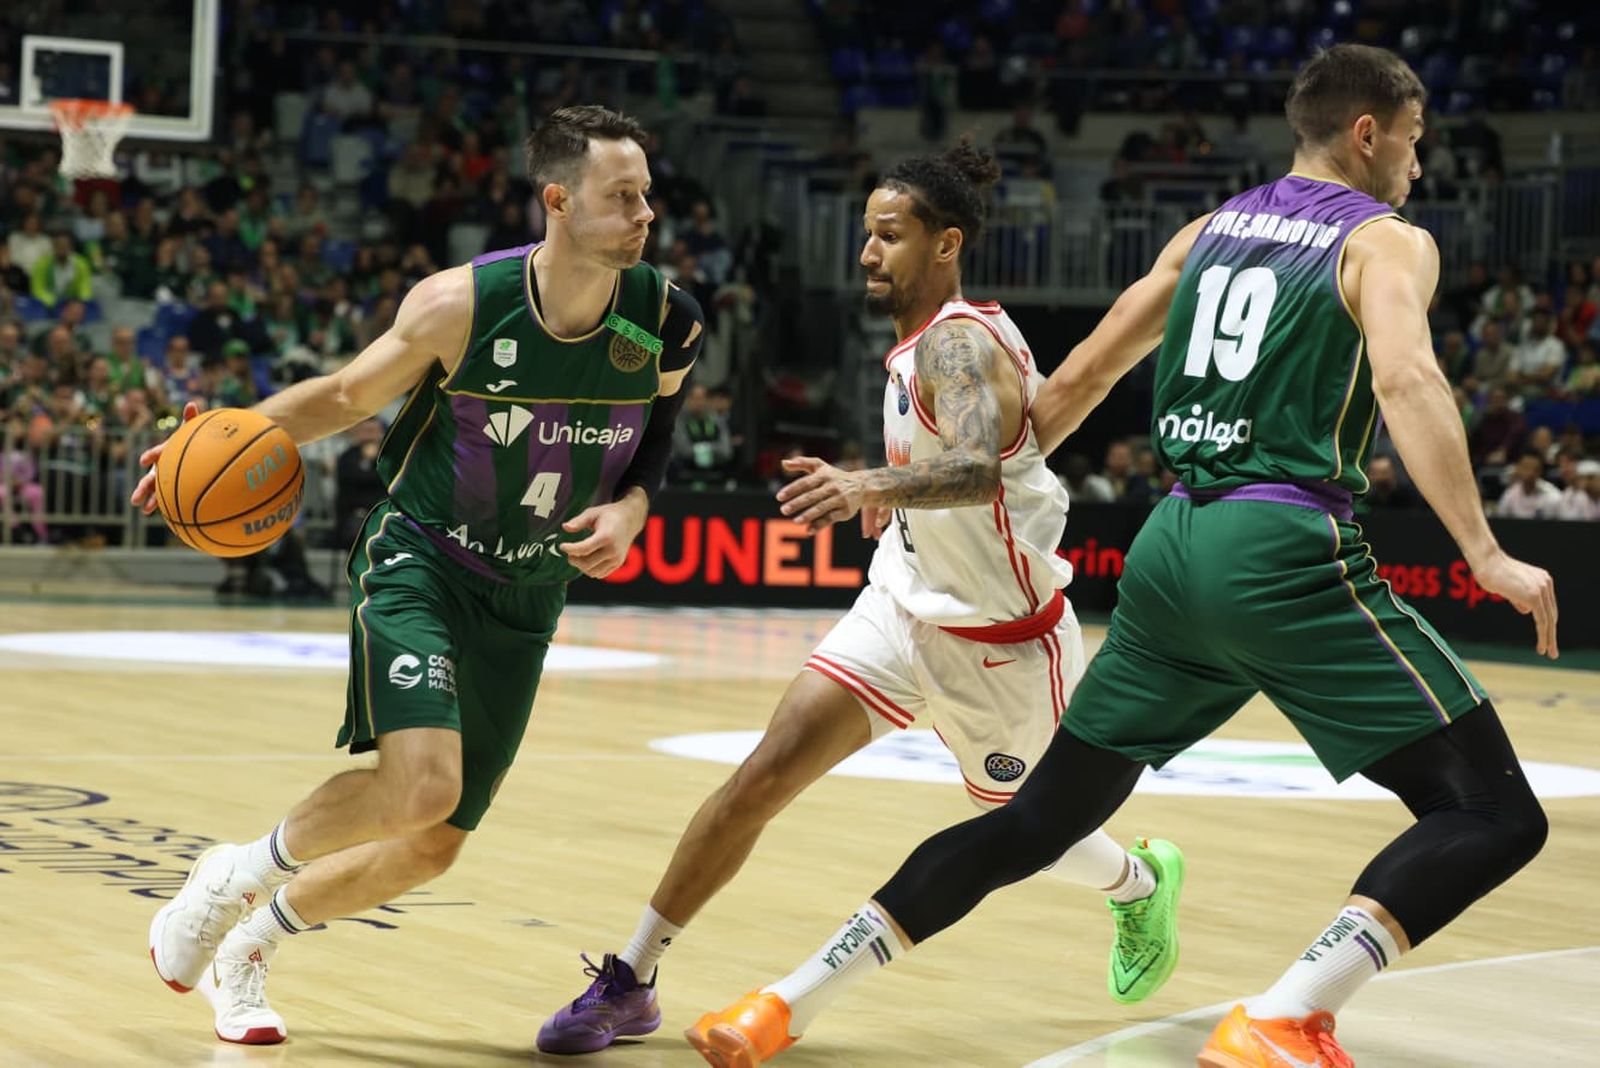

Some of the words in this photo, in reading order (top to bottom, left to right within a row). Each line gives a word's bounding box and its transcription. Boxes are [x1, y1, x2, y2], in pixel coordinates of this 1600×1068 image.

[1184, 264, 1278, 382] 19
[538, 421, 635, 450] Unicaja
[520, 472, 562, 520] 4
[1376, 562, 1441, 598] ross
[823, 917, 876, 970] UNICAJA
[1300, 916, 1359, 962] UNICAJA
